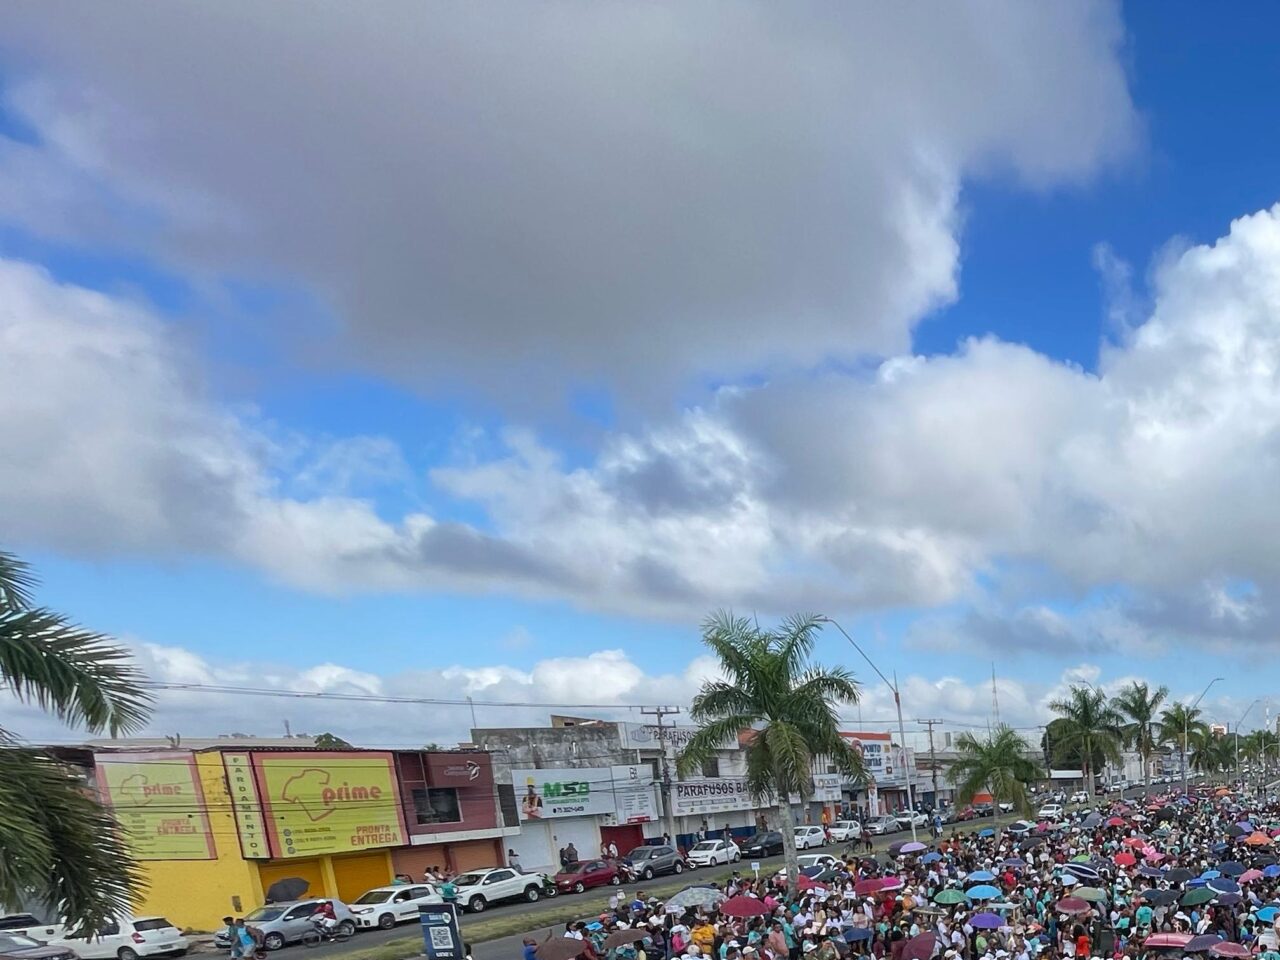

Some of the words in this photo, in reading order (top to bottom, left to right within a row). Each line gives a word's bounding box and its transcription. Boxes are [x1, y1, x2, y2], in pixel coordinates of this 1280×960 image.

[322, 782, 382, 806] prime
[677, 782, 734, 798] PARAFUSOS
[356, 824, 391, 834] PRONTA
[350, 832, 398, 847] ENTREGA
